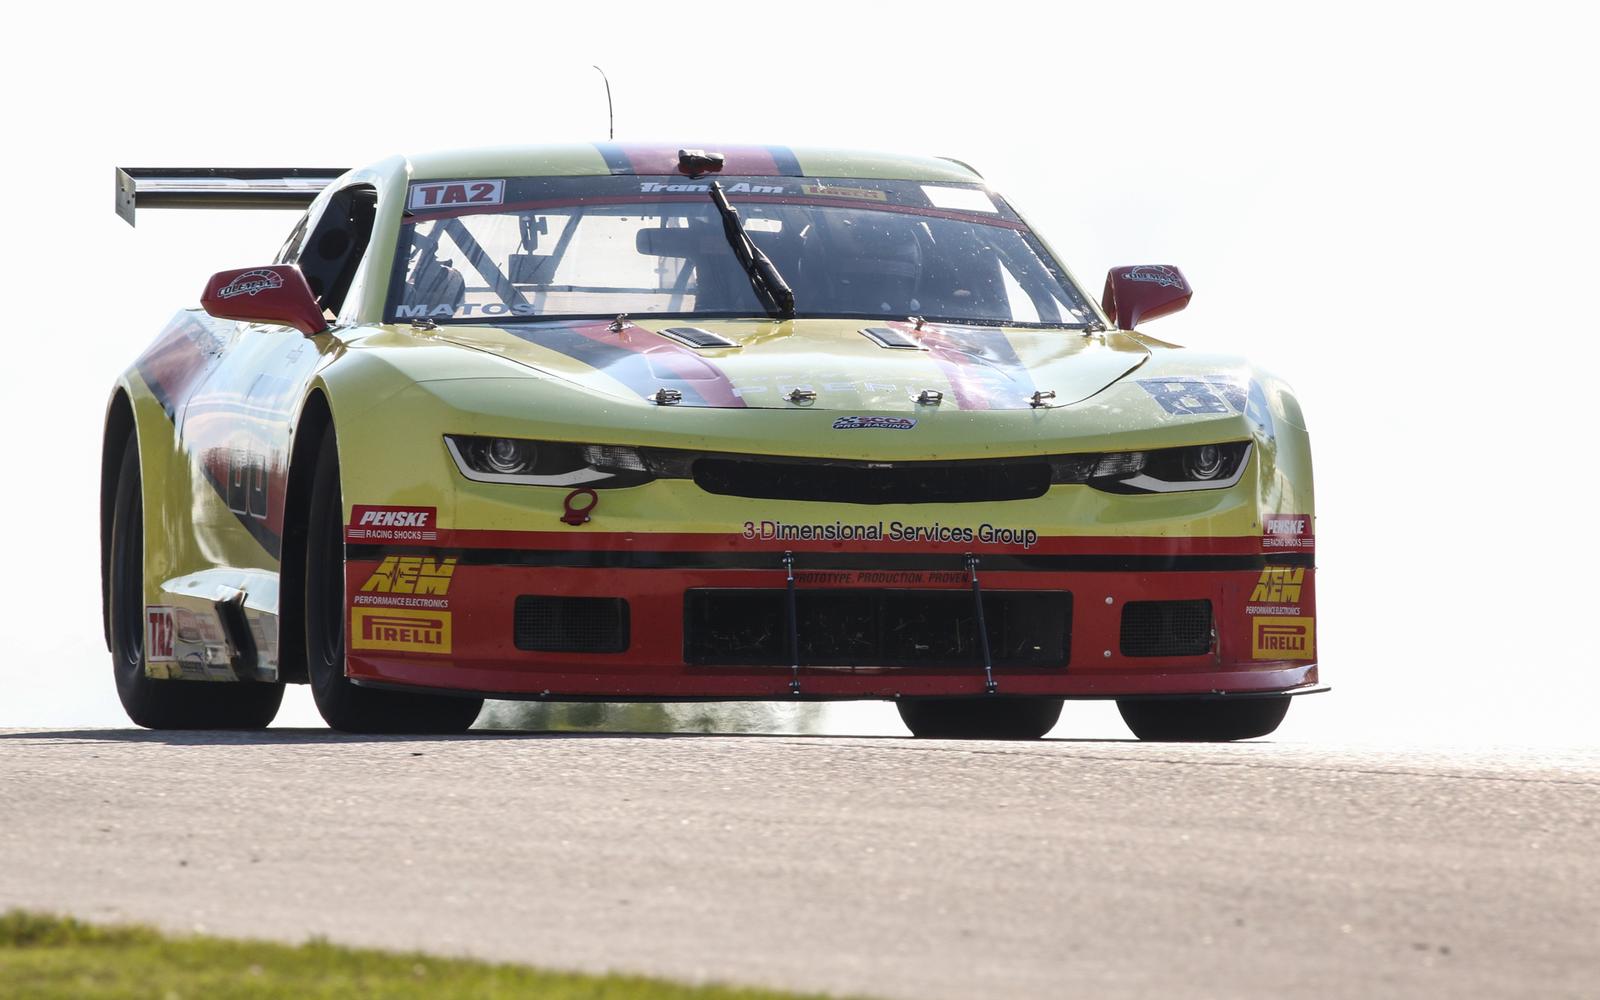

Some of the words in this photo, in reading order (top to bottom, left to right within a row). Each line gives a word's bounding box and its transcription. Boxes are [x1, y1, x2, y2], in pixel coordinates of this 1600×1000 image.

[420, 182, 495, 205] TA2
[727, 182, 784, 194] Am
[395, 303, 536, 318] MATOS
[863, 422, 911, 430] RACING
[359, 511, 429, 527] PENSKE
[1266, 519, 1305, 534] PENSKE
[366, 530, 393, 539] RACING
[393, 530, 422, 540] SHOCKS
[742, 520, 883, 541] 3-Dimensional
[889, 522, 973, 543] Services
[978, 524, 1037, 549] Group
[360, 555, 458, 596] AEM
[1248, 565, 1306, 603] AEM
[354, 595, 404, 606] PERFORMANCE
[405, 597, 449, 608] ELECTRONICS
[149, 612, 173, 656] TA2
[362, 614, 444, 645] PIRELLI
[1258, 624, 1307, 651] PIRELLI
